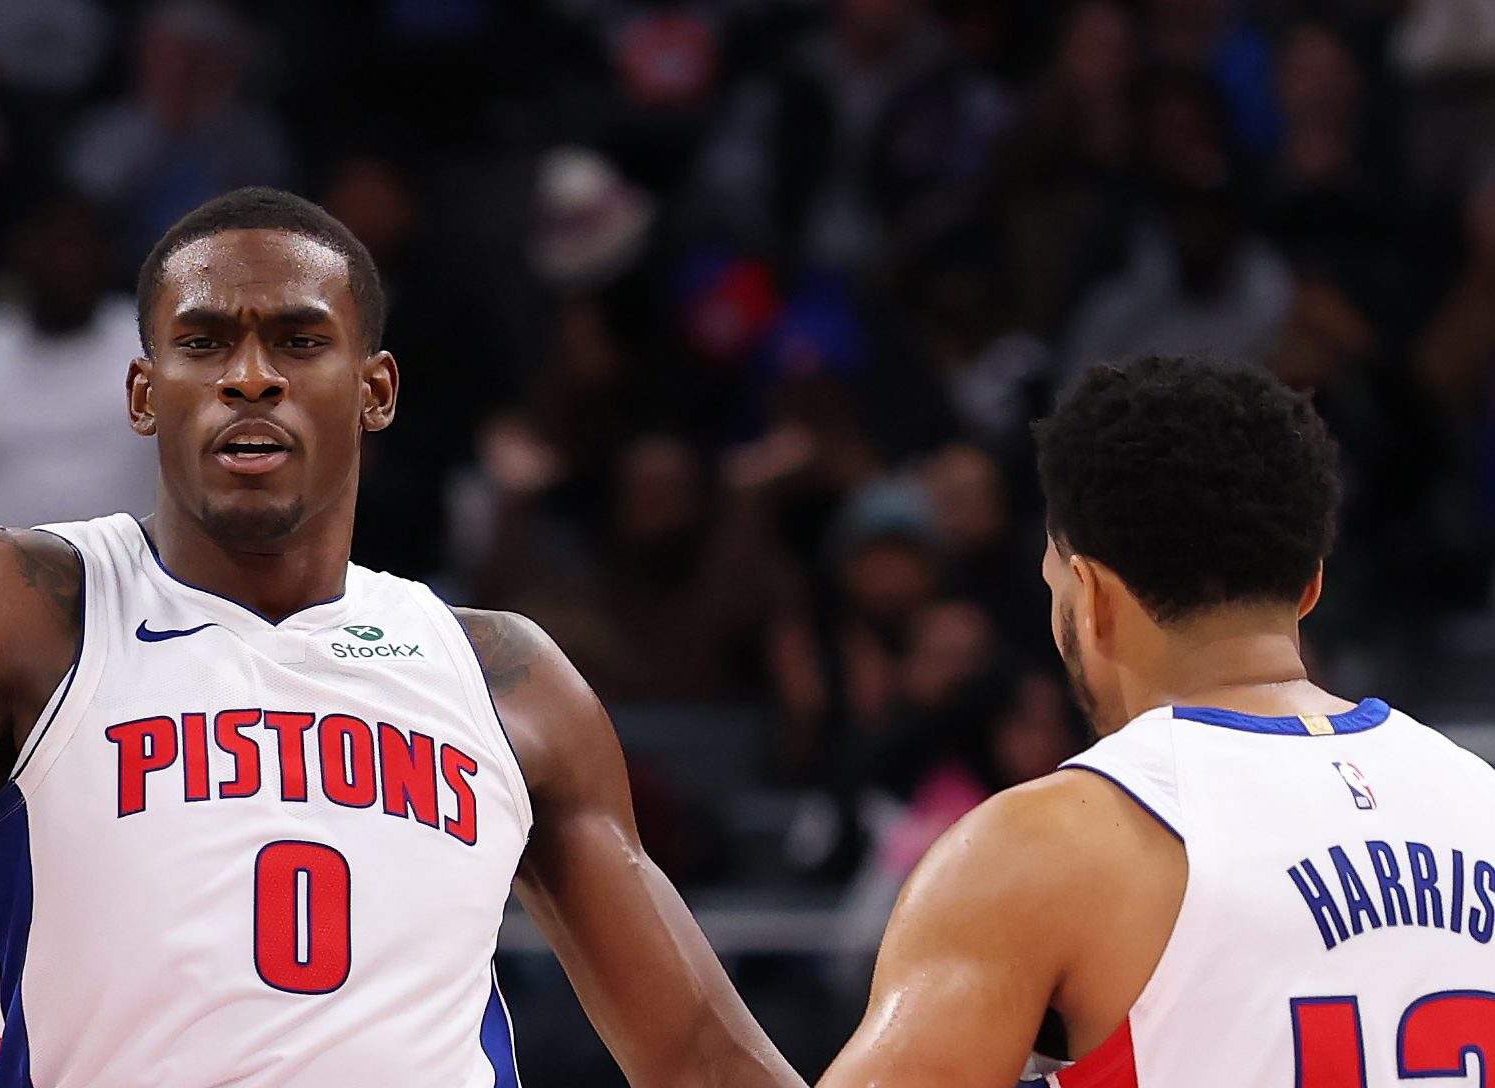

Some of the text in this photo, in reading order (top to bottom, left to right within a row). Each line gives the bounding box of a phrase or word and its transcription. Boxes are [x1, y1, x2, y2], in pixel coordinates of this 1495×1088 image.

[105, 708, 478, 846] PISTONS
[254, 840, 351, 995] 0
[1287, 840, 1495, 950] HARRIS
